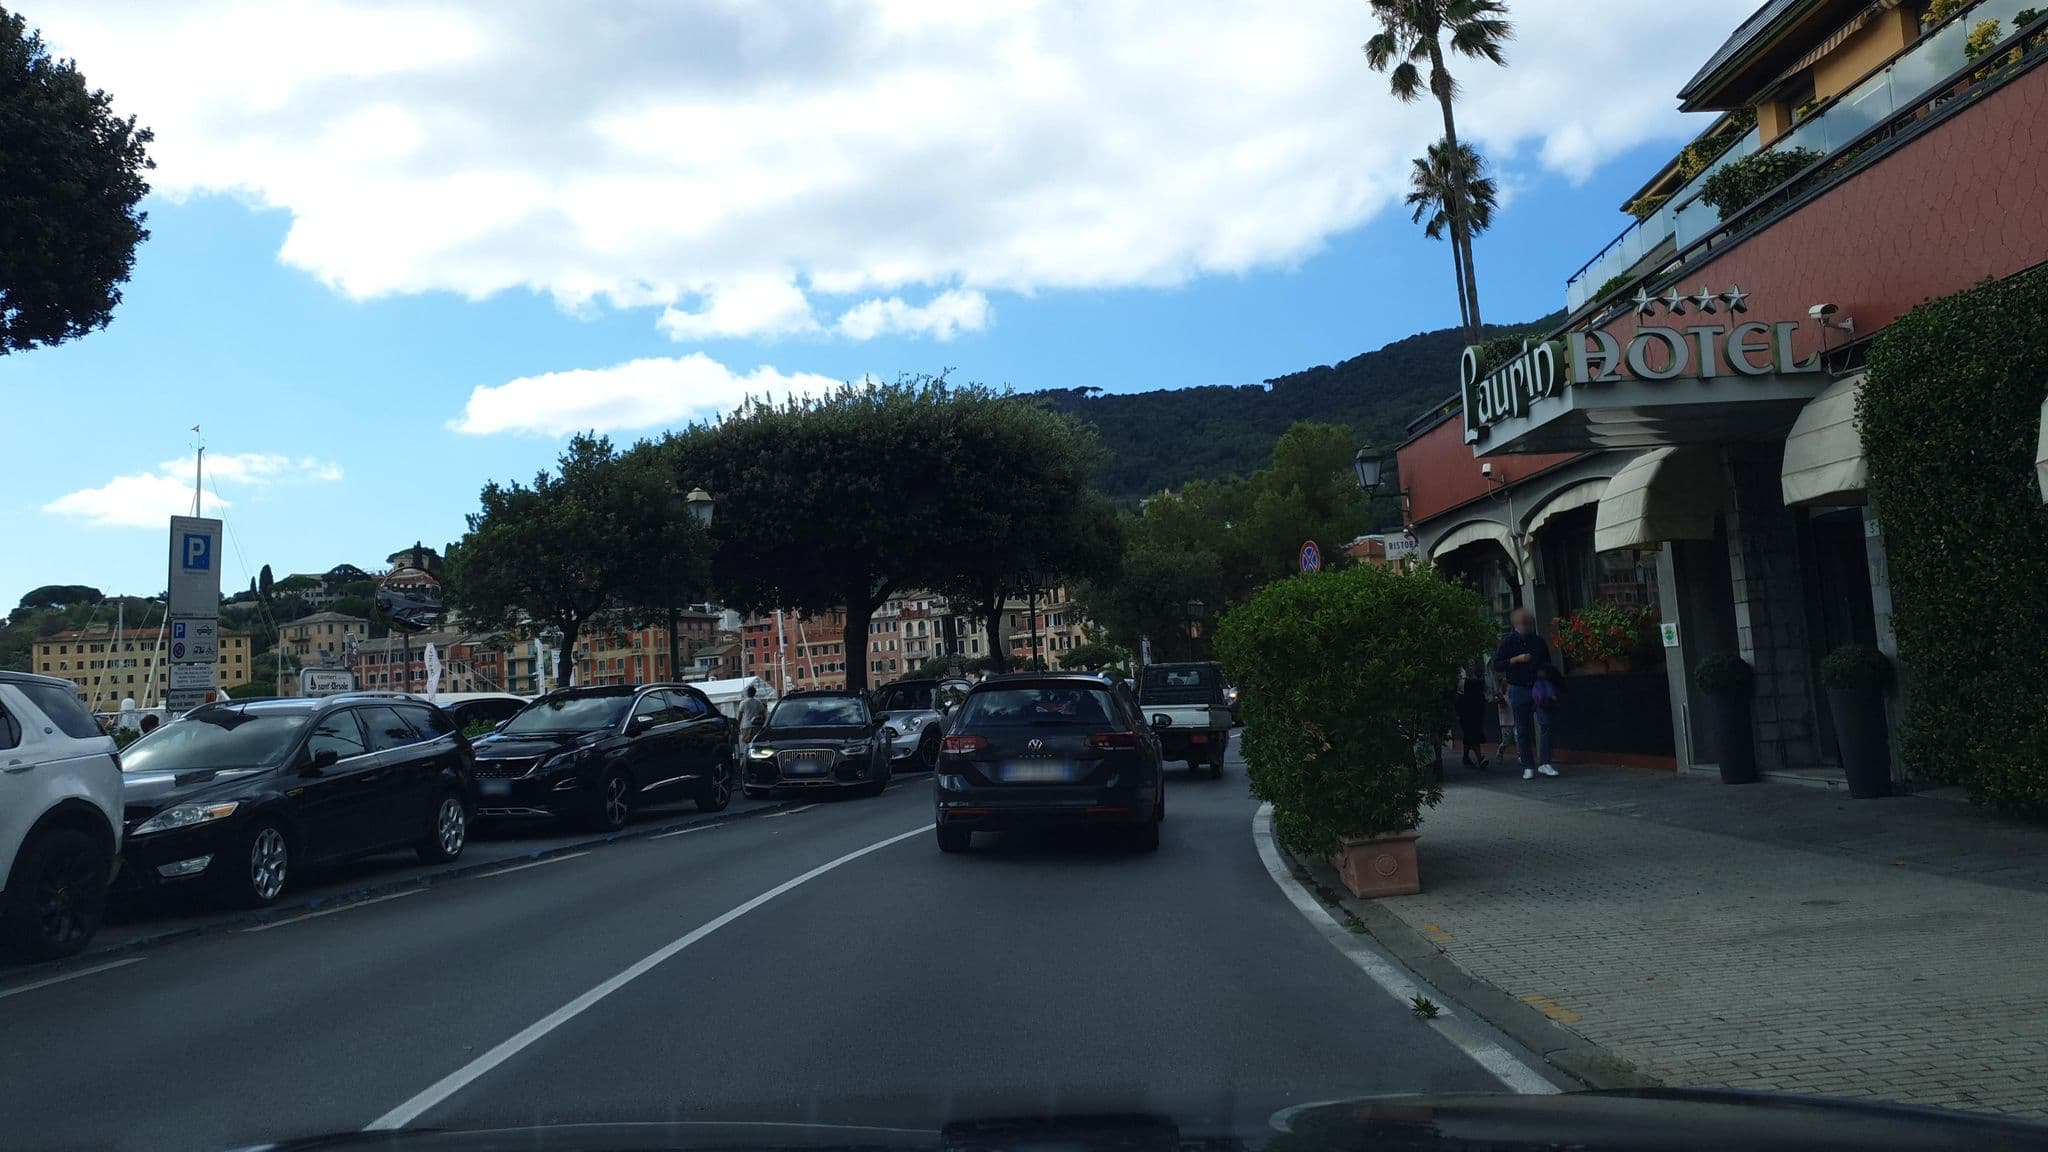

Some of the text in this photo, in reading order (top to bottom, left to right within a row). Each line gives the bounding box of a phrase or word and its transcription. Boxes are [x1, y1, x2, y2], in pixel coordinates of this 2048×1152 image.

[1461, 321, 1822, 446] Laurin HOTEL
[188, 537, 205, 566] P
[176, 624, 184, 637] P
